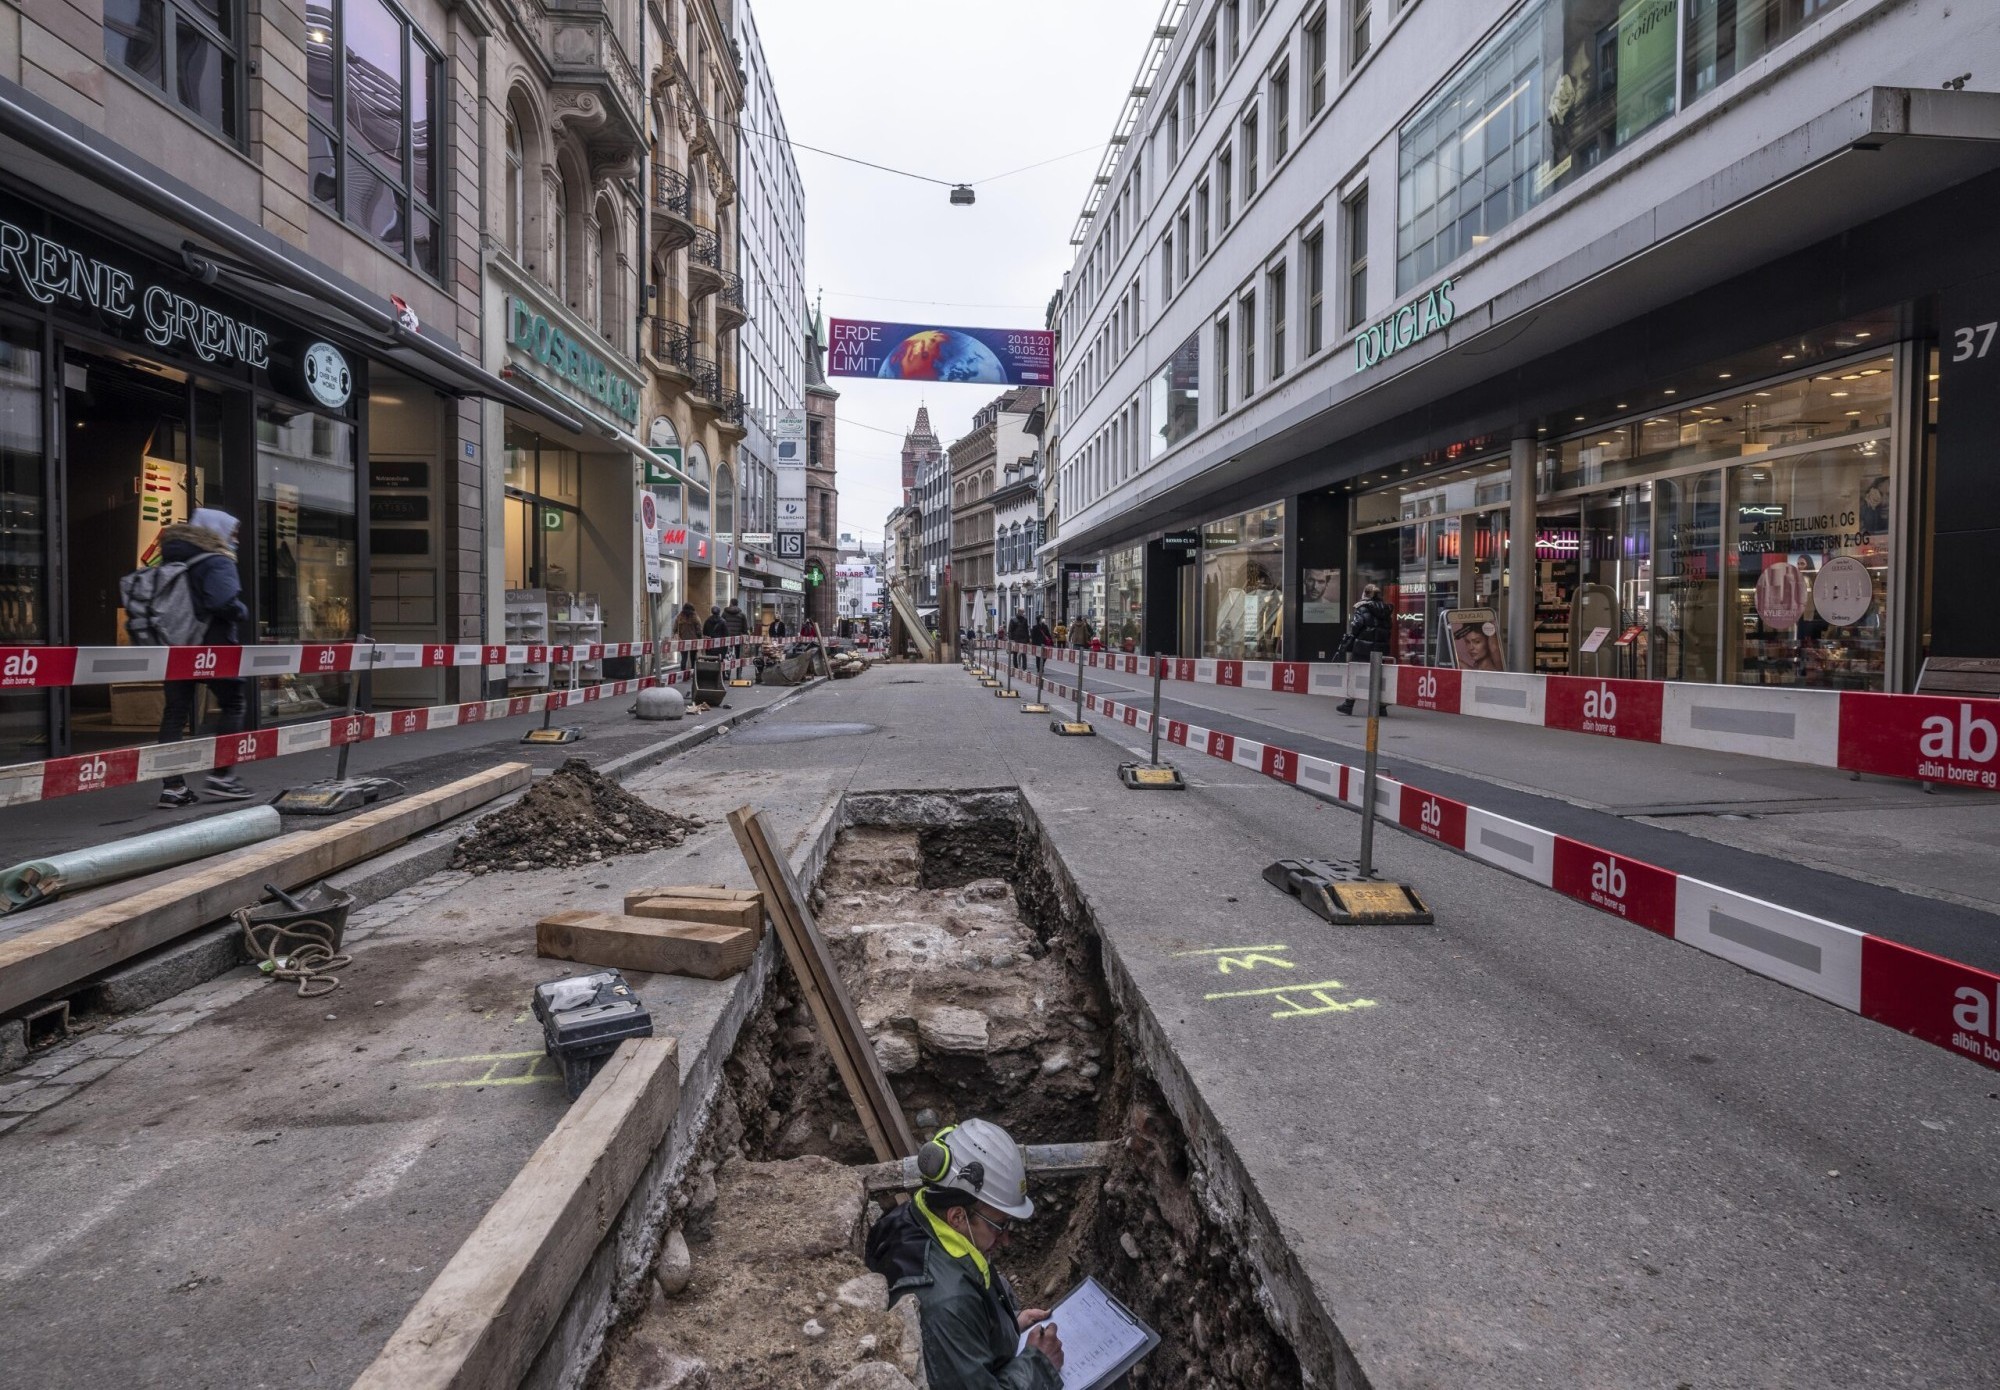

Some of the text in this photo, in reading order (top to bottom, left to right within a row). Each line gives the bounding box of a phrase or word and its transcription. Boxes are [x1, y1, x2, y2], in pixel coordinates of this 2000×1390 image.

[144, 286, 269, 370] GRENE
[834, 324, 882, 342] ERDE
[1355, 280, 1455, 372] DOUGLAS
[834, 340, 864, 356] AM
[1008, 334, 1050, 346] 20.11.20
[1952, 322, 1998, 362] 37
[506, 295, 640, 425] DOSENBACH
[834, 356, 880, 372] LIMIT
[651, 454, 677, 479] D
[546, 513, 560, 528] D
[1758, 512, 1855, 534] UFTABTEILUNG 1. OG
[664, 530, 686, 544] H&M
[1807, 535, 1841, 550] DESIGN
[1844, 534, 1852, 548] 2.
[1854, 532, 1870, 546] OG
[1672, 562, 1704, 575] Dior
[4, 650, 38, 675] ab
[194, 648, 216, 669] ab
[320, 647, 335, 664] ab
[434, 646, 443, 660] ab
[1224, 665, 1232, 679] ab
[1284, 666, 1294, 684] ab
[1418, 670, 1436, 698] ab
[1584, 682, 1616, 719] ab
[347, 719, 360, 736] ab
[405, 711, 416, 726] ab
[1582, 721, 1616, 735] albin borer ag
[1920, 704, 1998, 762] ab
[238, 734, 256, 754] ab
[1216, 736, 1224, 751] ab
[79, 755, 107, 782] ab
[1274, 752, 1284, 770] ab
[1918, 761, 1996, 788] albin borer ag
[1422, 797, 1440, 826] ab
[1592, 857, 1626, 898] ab
[1952, 1032, 2000, 1062] albin bo
